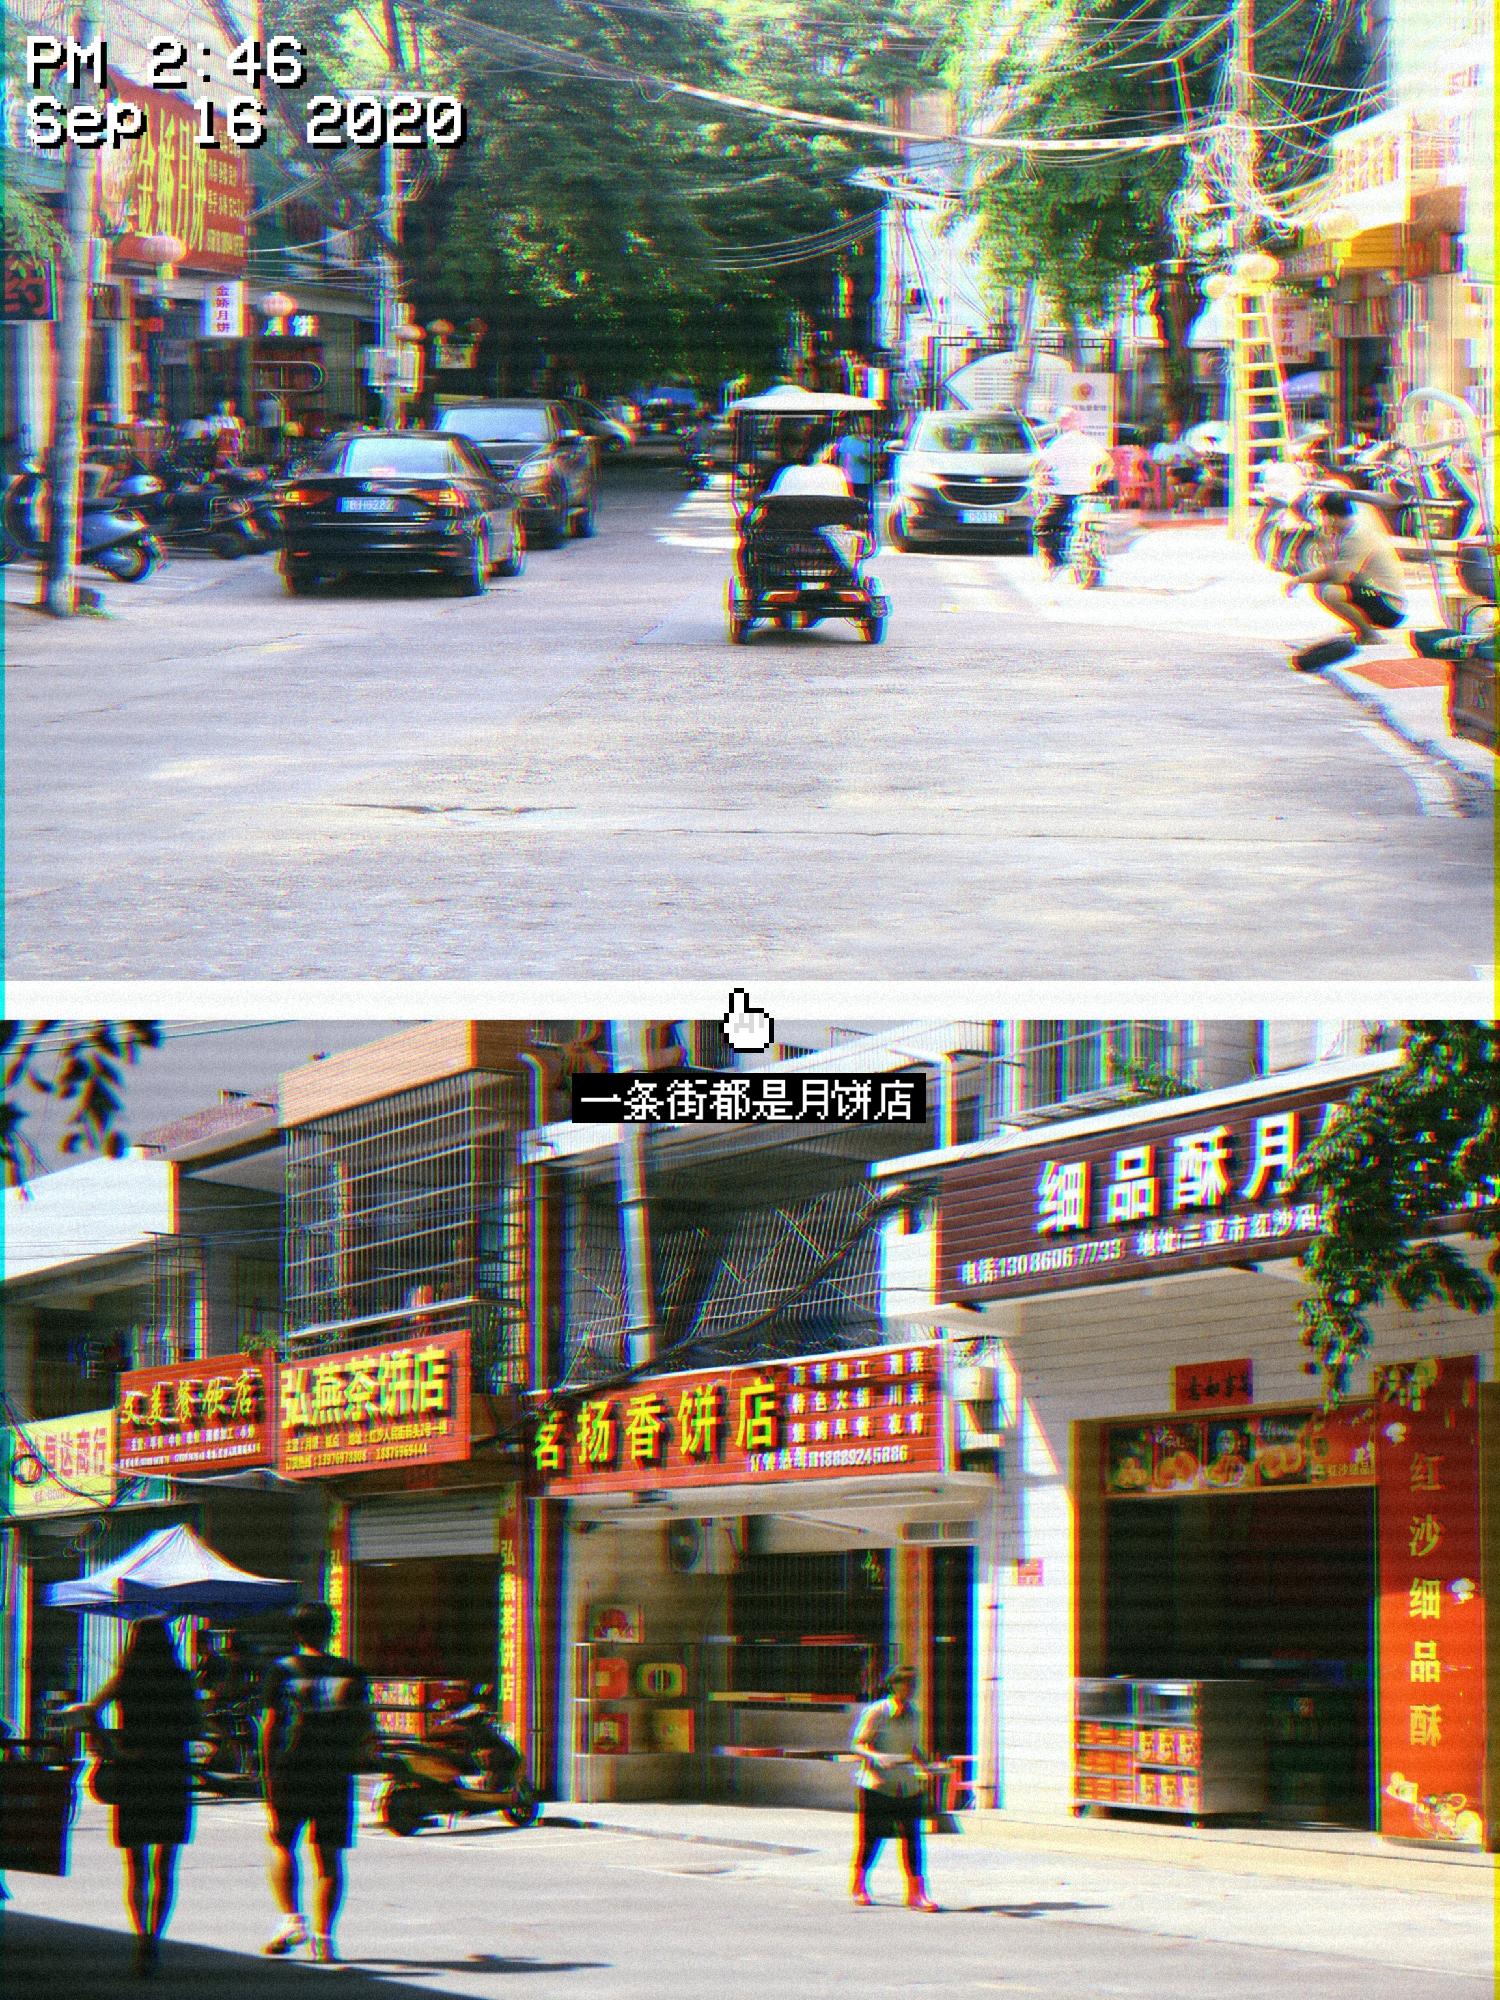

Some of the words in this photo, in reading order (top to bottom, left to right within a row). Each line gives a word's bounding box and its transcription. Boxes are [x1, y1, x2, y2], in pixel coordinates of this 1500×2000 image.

[1036, 1110, 1340, 1233] 细品酥月
[279, 1344, 449, 1429] 弘燕茶饼店
[1408, 1452, 1446, 1748] 红沙细品酥
